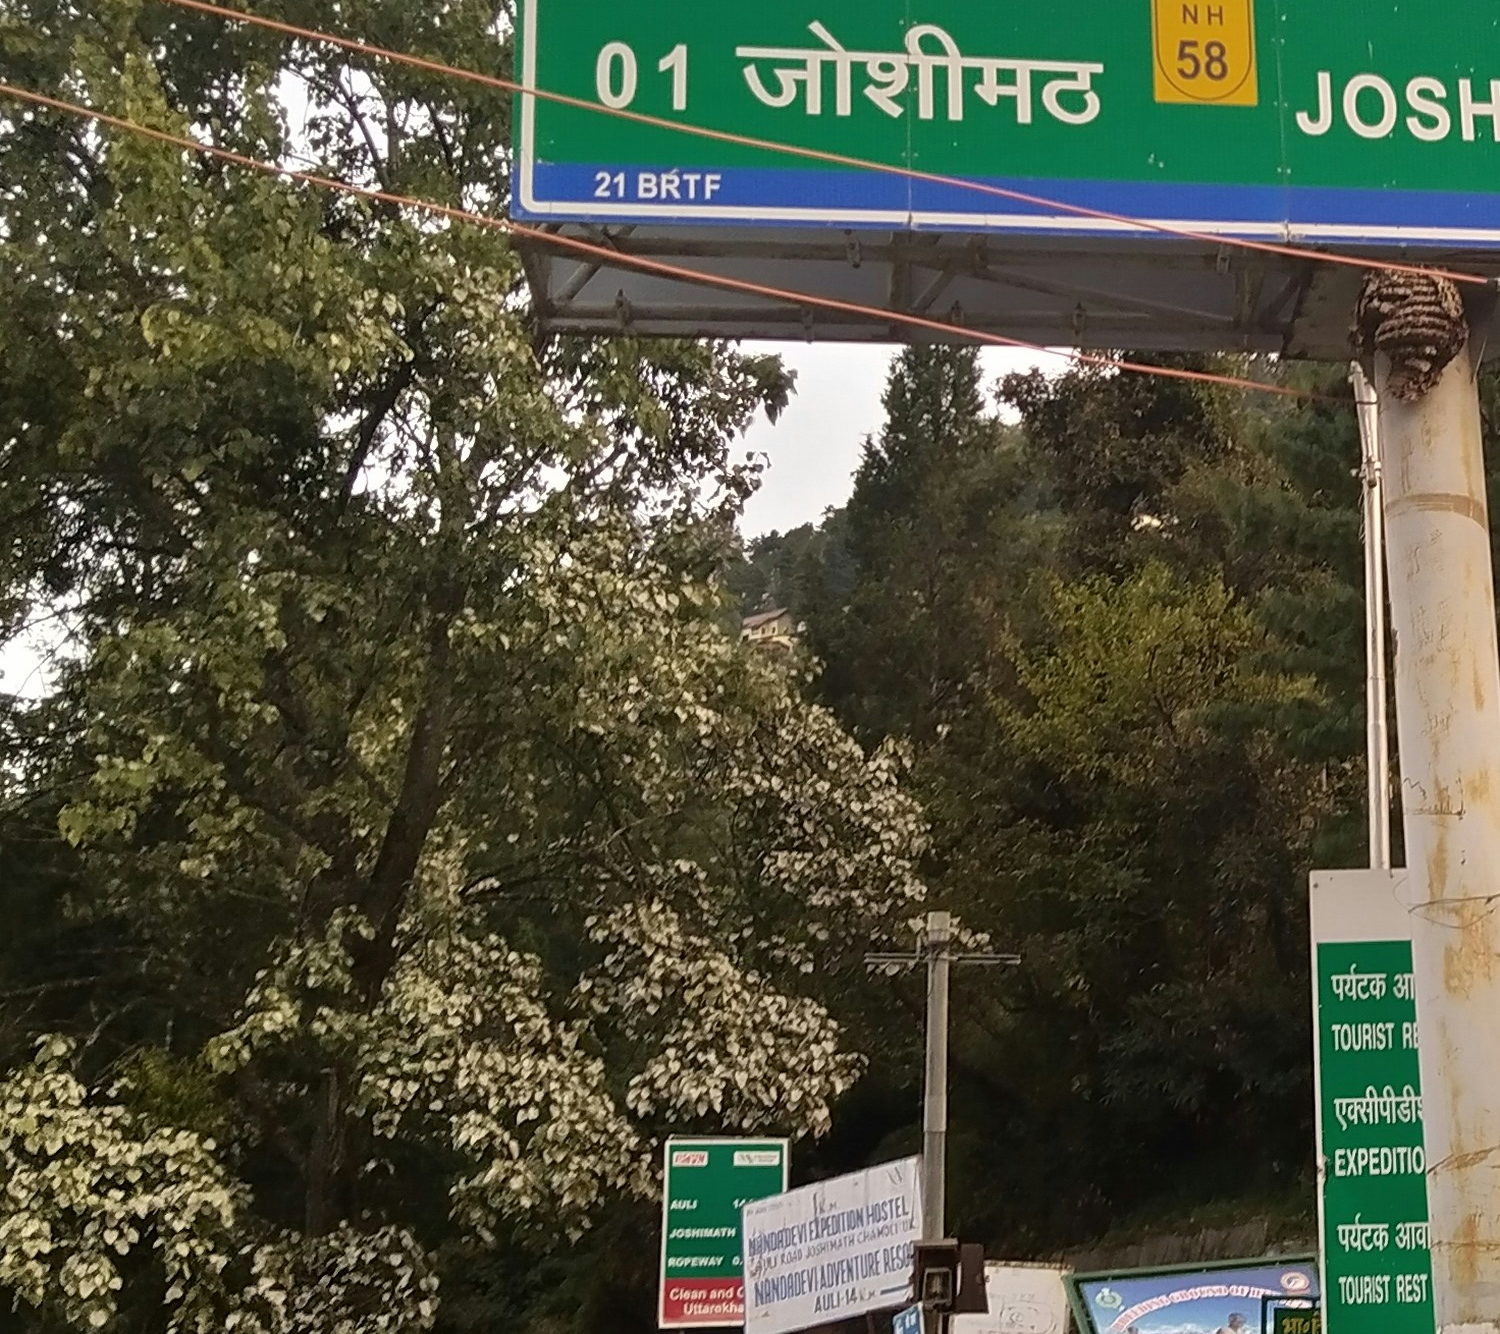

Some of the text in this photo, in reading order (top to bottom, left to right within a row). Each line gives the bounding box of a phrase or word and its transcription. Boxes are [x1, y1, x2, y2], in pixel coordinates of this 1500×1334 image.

[595, 42, 688, 111] 01
[735, 20, 1104, 125] जोशीमठ
[1177, 40, 1230, 82] 58
[594, 171, 721, 200] 21 BRTF
[1331, 964, 1386, 1001] पर्यटक
[1332, 1023, 1394, 1051] TOURIST
[1402, 1022, 1419, 1049] RE
[1334, 1146, 1425, 1176] EXPEDITIO
[670, 1199, 698, 1210] AULI
[808, 1207, 865, 1241] EXPEDITION
[865, 1195, 909, 1224] HOSTEL
[669, 1227, 737, 1239] JOSHIMATH
[780, 1249, 803, 1266] ROAD
[805, 1237, 855, 1259] JOSHIMATH
[857, 1223, 899, 1244] CHAMOLI
[1337, 1213, 1430, 1252] पर्यटक आवा
[668, 1256, 725, 1268] ROPEWAY
[820, 1250, 881, 1290] ADVENTURE
[669, 1287, 707, 1301] Clean
[709, 1286, 734, 1300] and
[1338, 1274, 1390, 1304] TOURIST
[1396, 1273, 1428, 1303] REST
